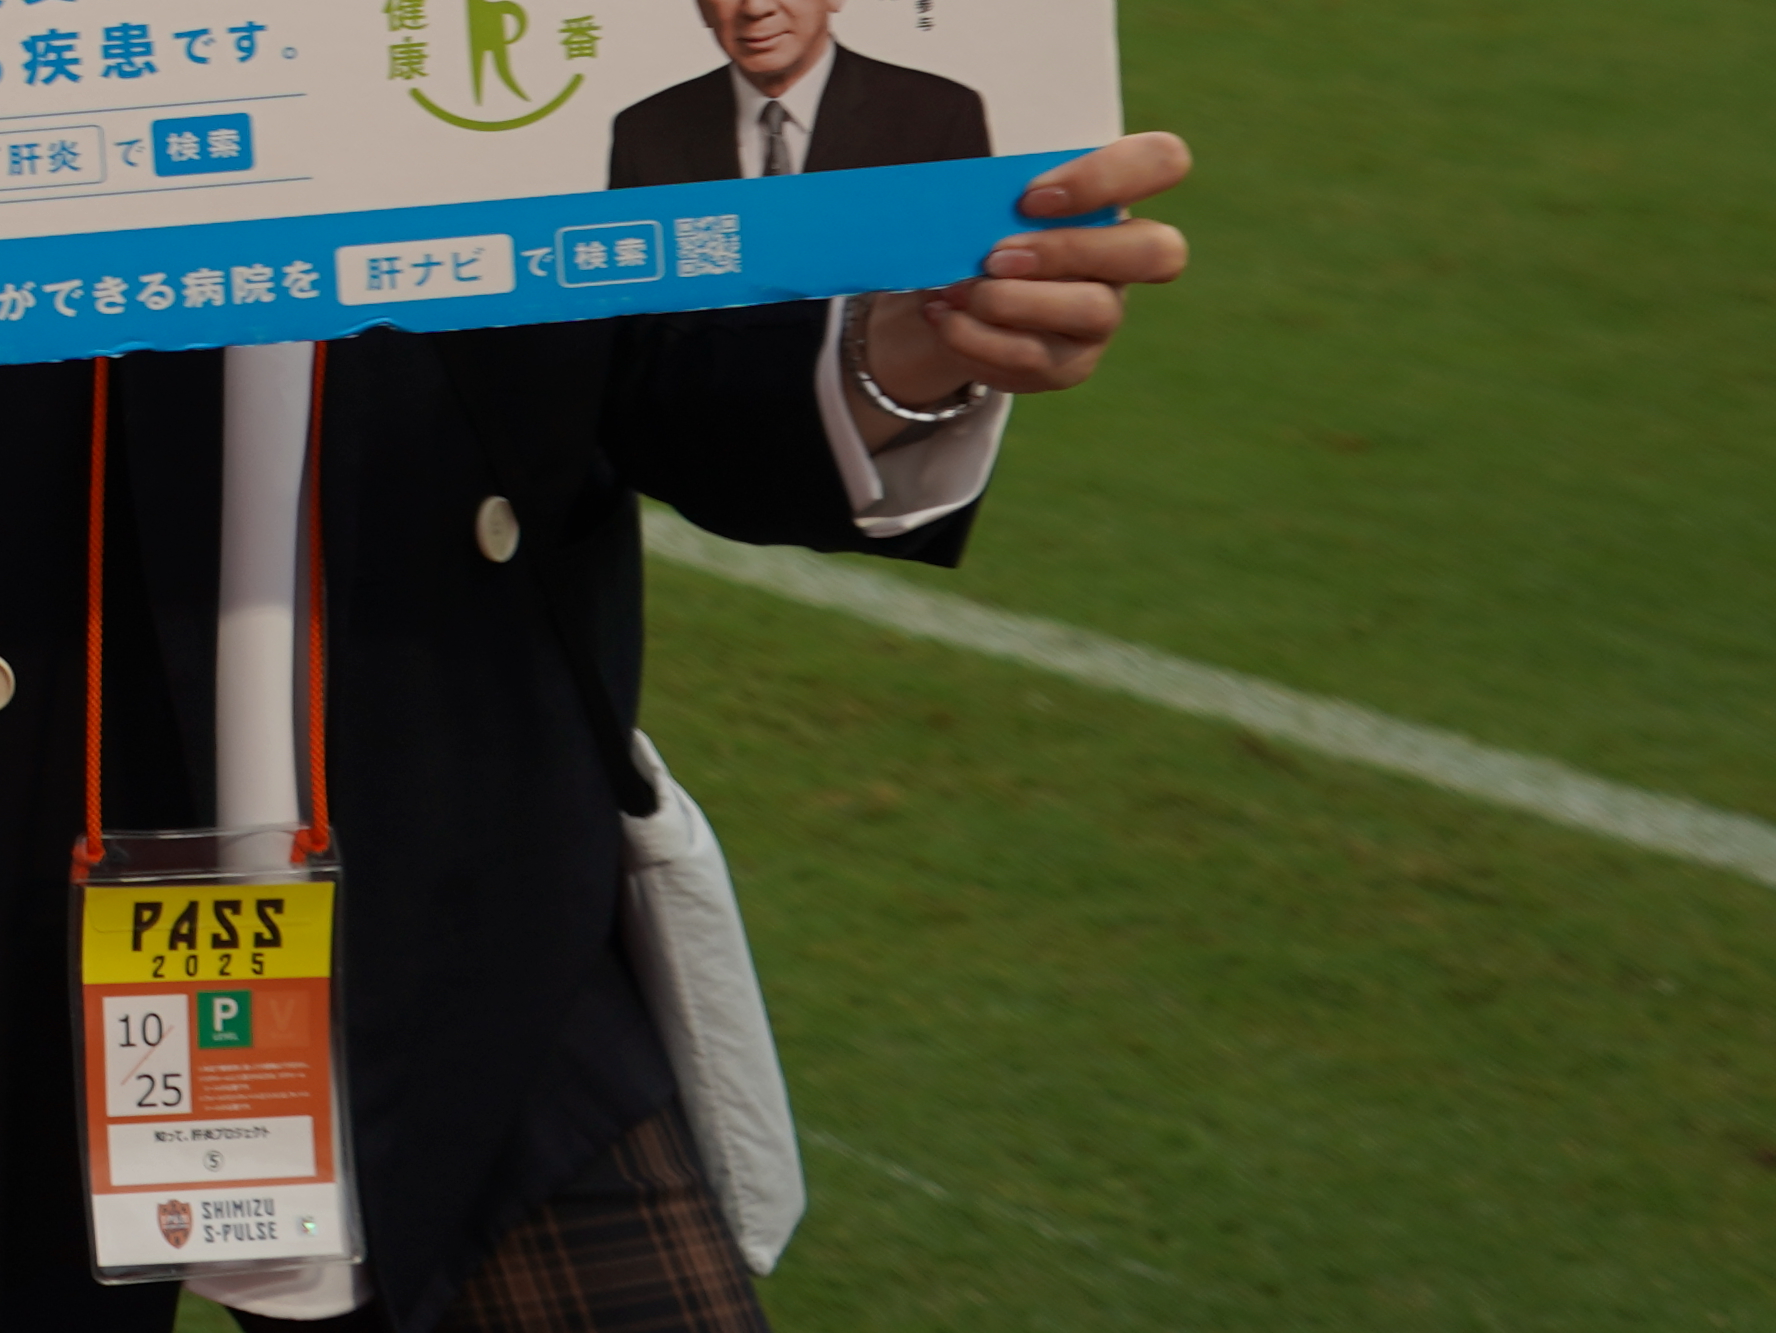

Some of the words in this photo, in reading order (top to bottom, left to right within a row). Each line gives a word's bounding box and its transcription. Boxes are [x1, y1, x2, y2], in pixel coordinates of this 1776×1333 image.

[113, 137, 147, 168] で
[165, 128, 242, 163] 検索
[365, 246, 486, 292] 肝ナビ
[520, 246, 554, 278] で
[573, 237, 648, 271] 検索
[130, 898, 286, 952] PASS
[152, 952, 266, 979] 2025
[117, 1012, 164, 1048] 10
[212, 996, 239, 1032] P
[135, 1073, 183, 1109] 25
[200, 1198, 276, 1220] SHIMIZU
[204, 1221, 279, 1244] S-PULSE
